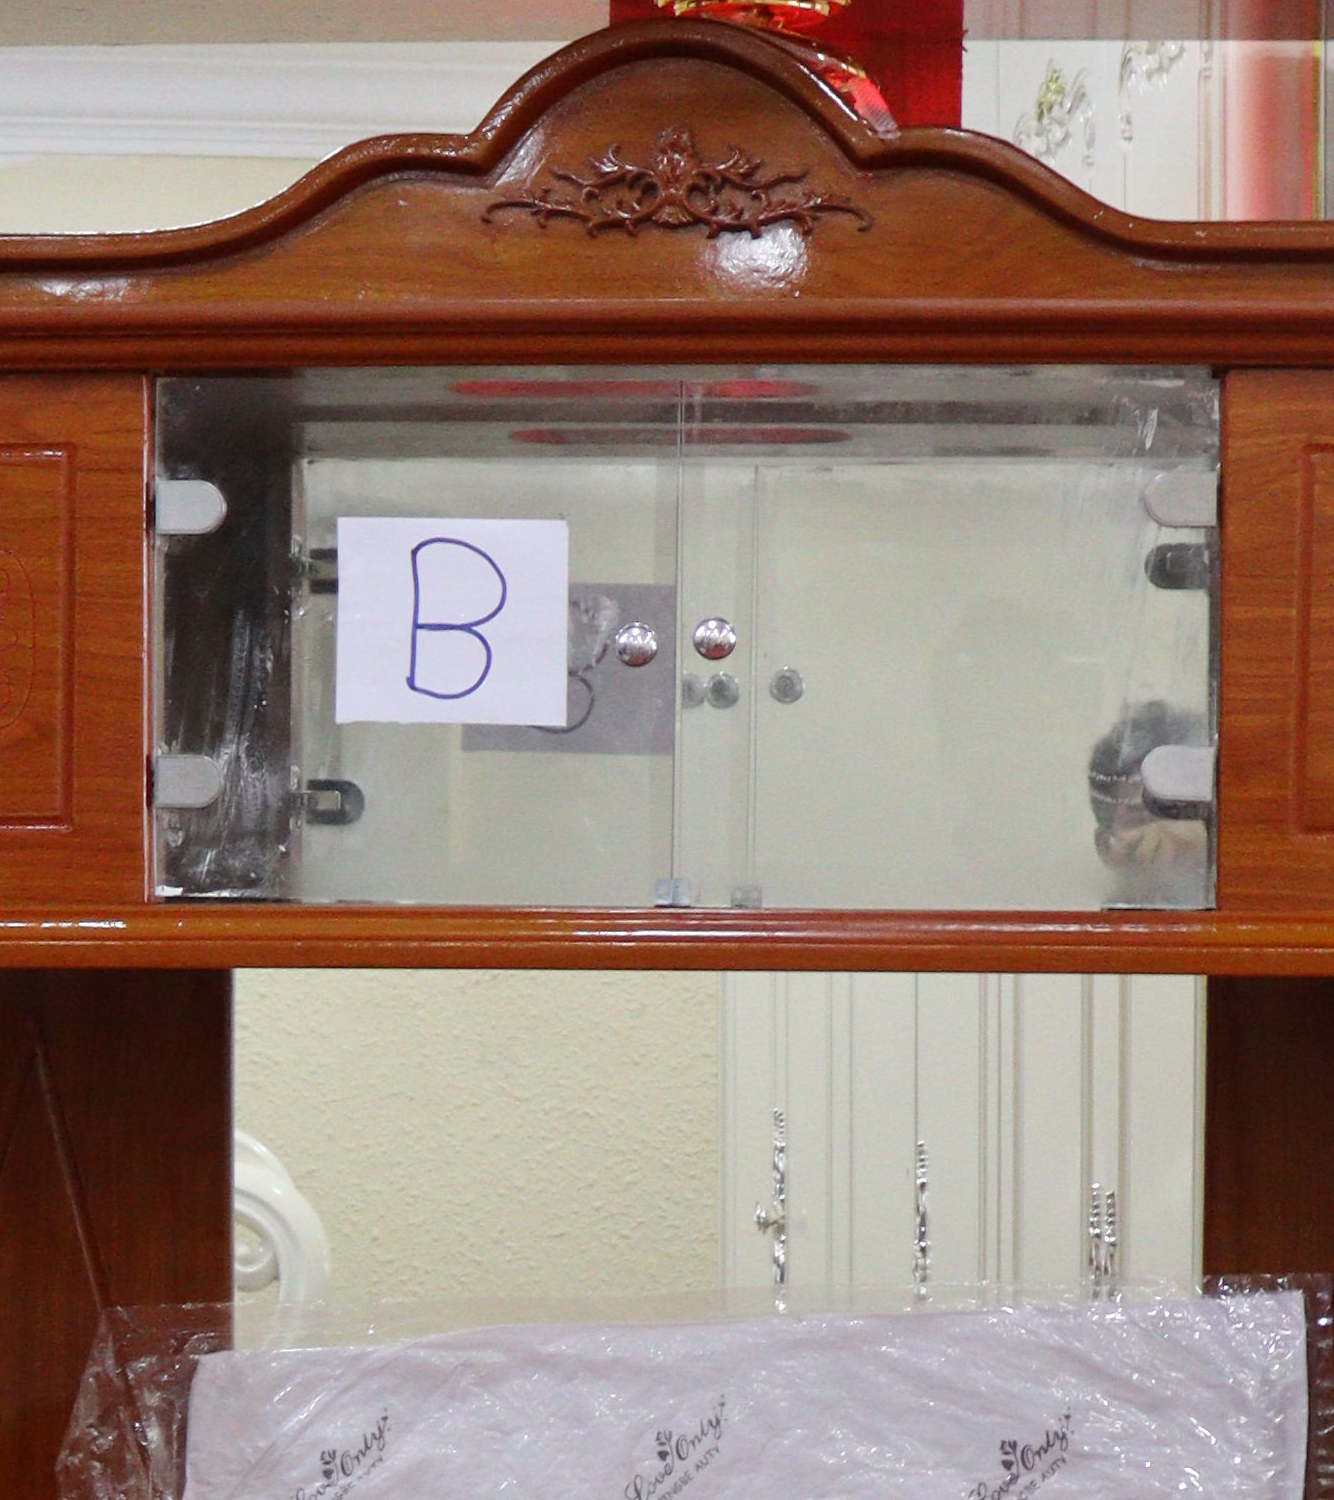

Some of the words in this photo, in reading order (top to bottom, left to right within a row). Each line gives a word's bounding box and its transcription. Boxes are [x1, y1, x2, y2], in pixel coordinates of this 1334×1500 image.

[405, 536, 507, 699] B
[340, 1419, 386, 1477] Only
[675, 1410, 723, 1461] Only
[1020, 1422, 1069, 1471] Only
